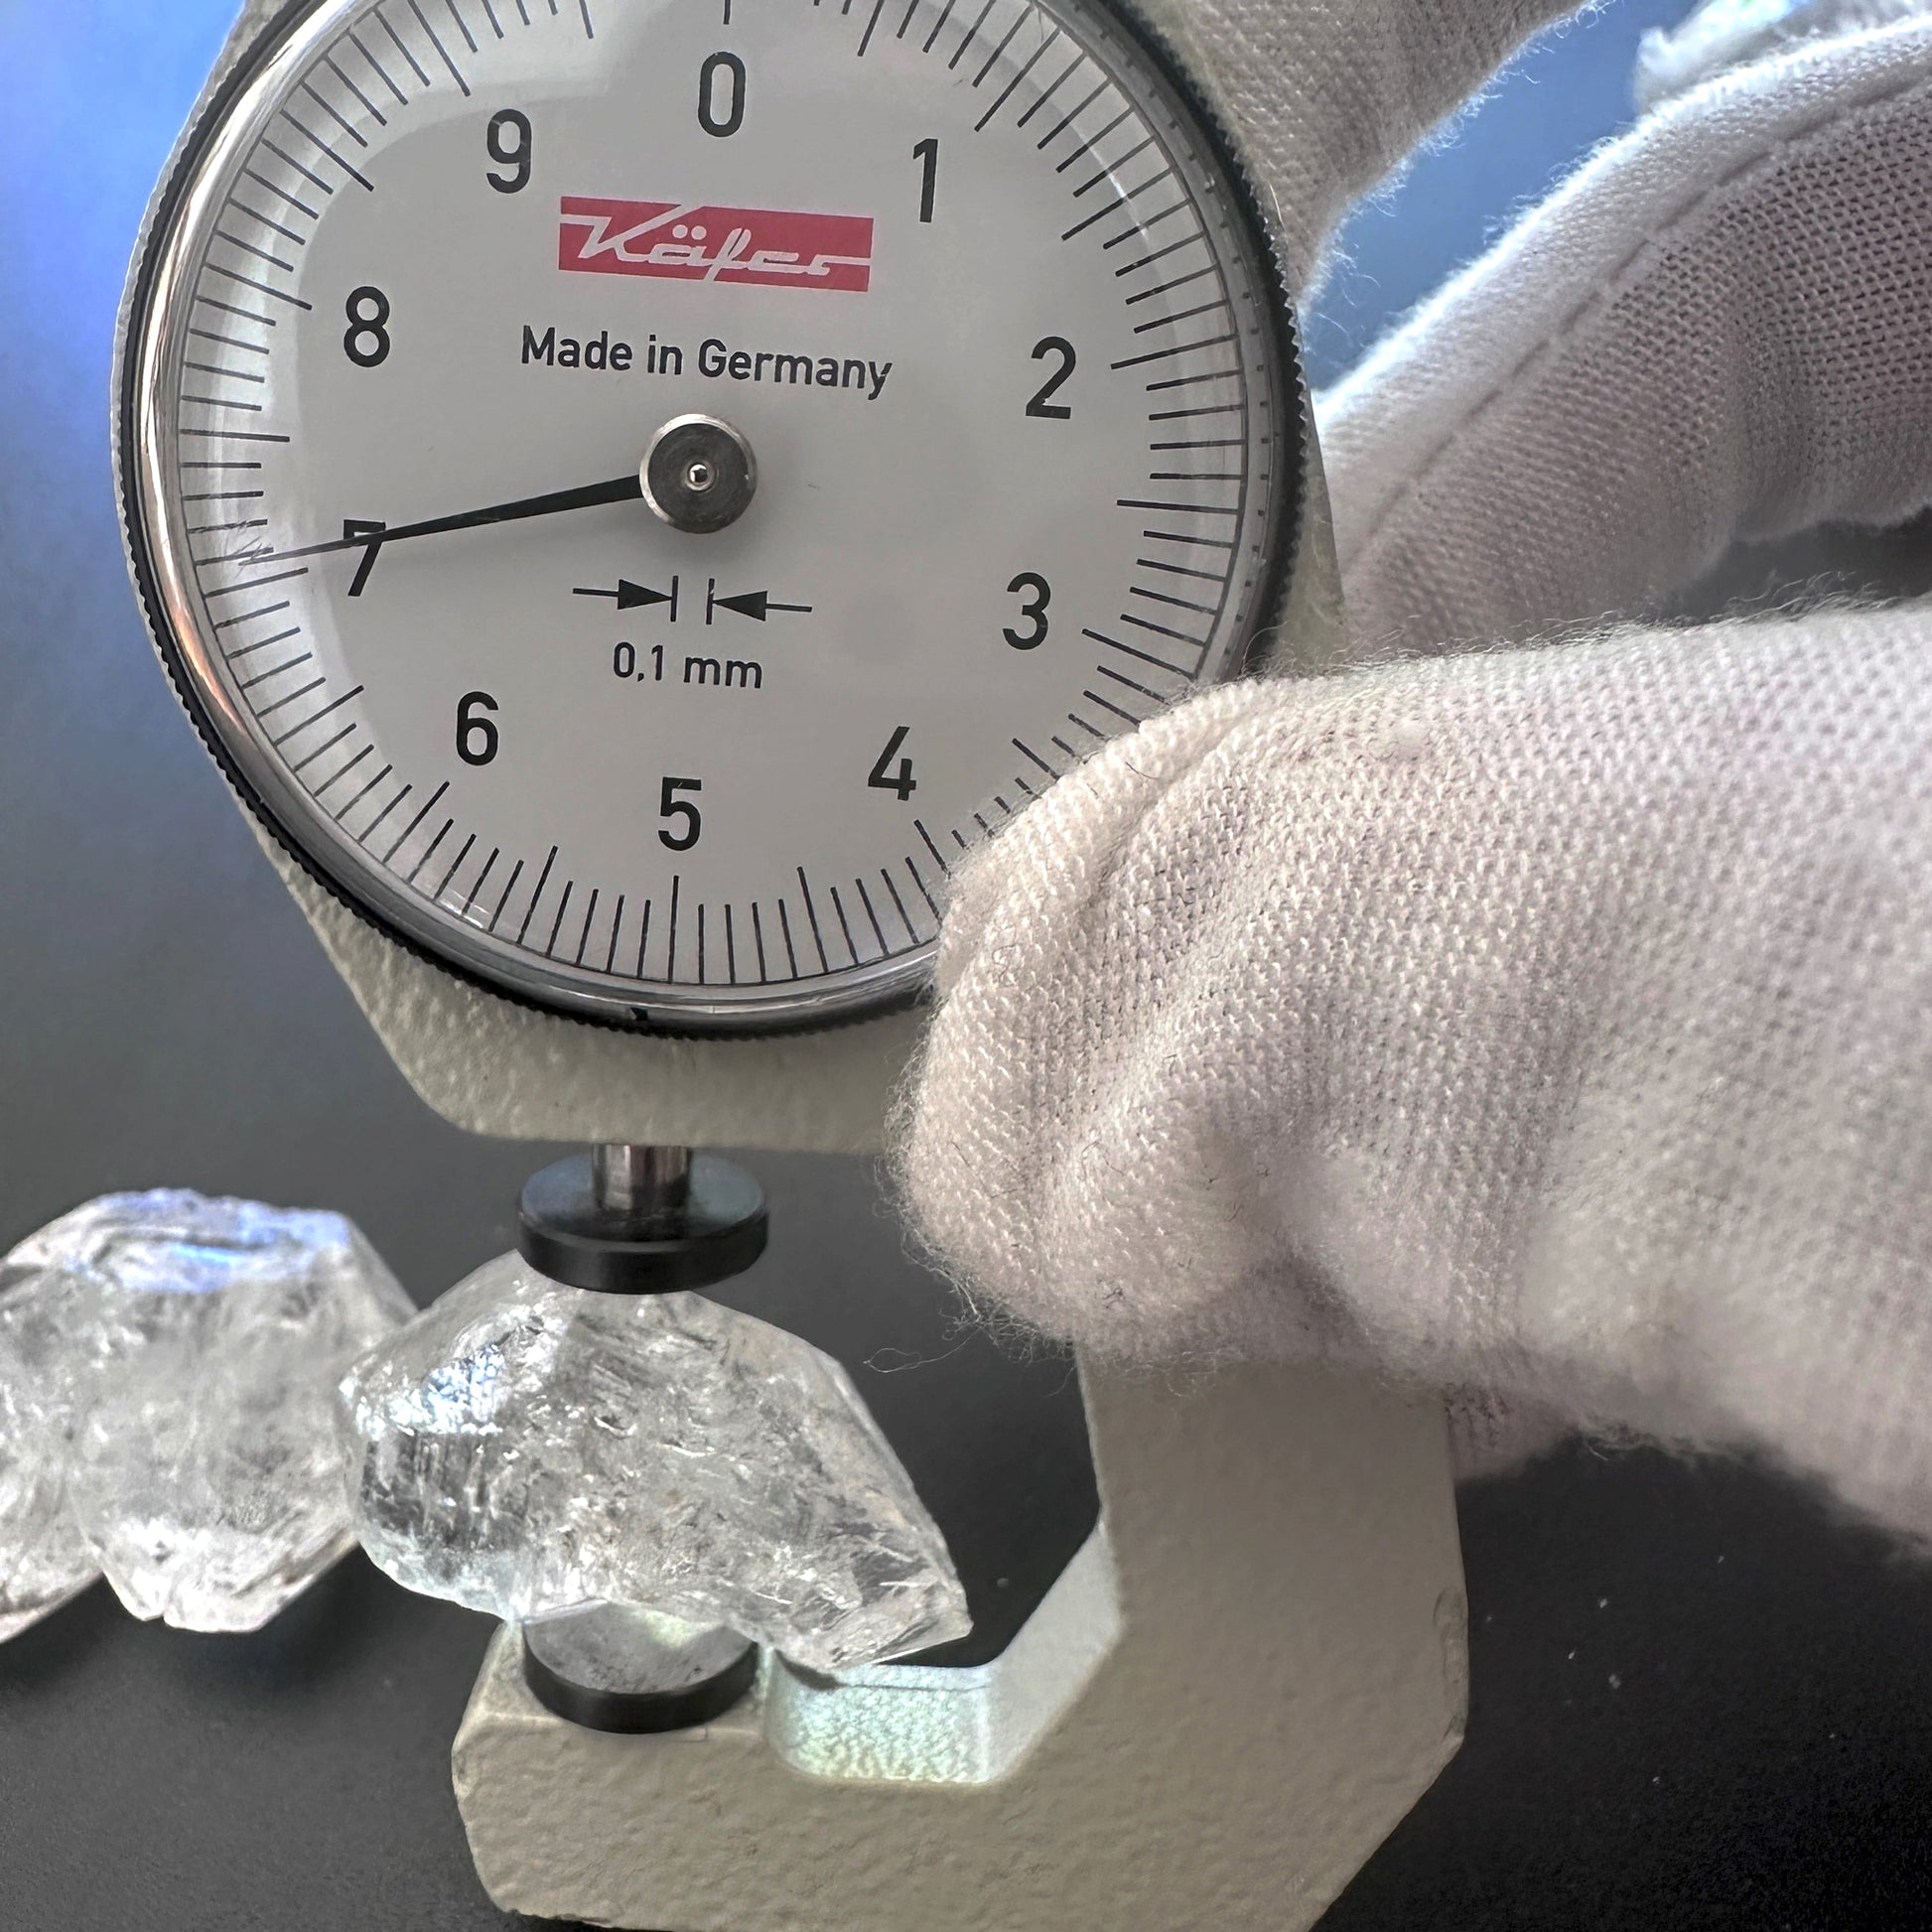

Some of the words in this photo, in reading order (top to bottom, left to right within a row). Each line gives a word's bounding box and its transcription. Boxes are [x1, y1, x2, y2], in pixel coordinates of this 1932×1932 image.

[697, 51, 747, 138] 0
[485, 108, 532, 195] 9
[912, 138, 938, 223] 1
[344, 286, 390, 368] 8
[521, 325, 633, 371] Made
[647, 334, 683, 375] in
[698, 339, 893, 401] Germany
[1025, 336, 1076, 420] 2
[343, 518, 386, 598] 7
[1002, 572, 1051, 651] 3
[613, 641, 664, 682] 0,1
[683, 656, 762, 689] mm
[456, 691, 499, 766] 6
[867, 726, 917, 802] 4
[657, 776, 702, 852] 5
